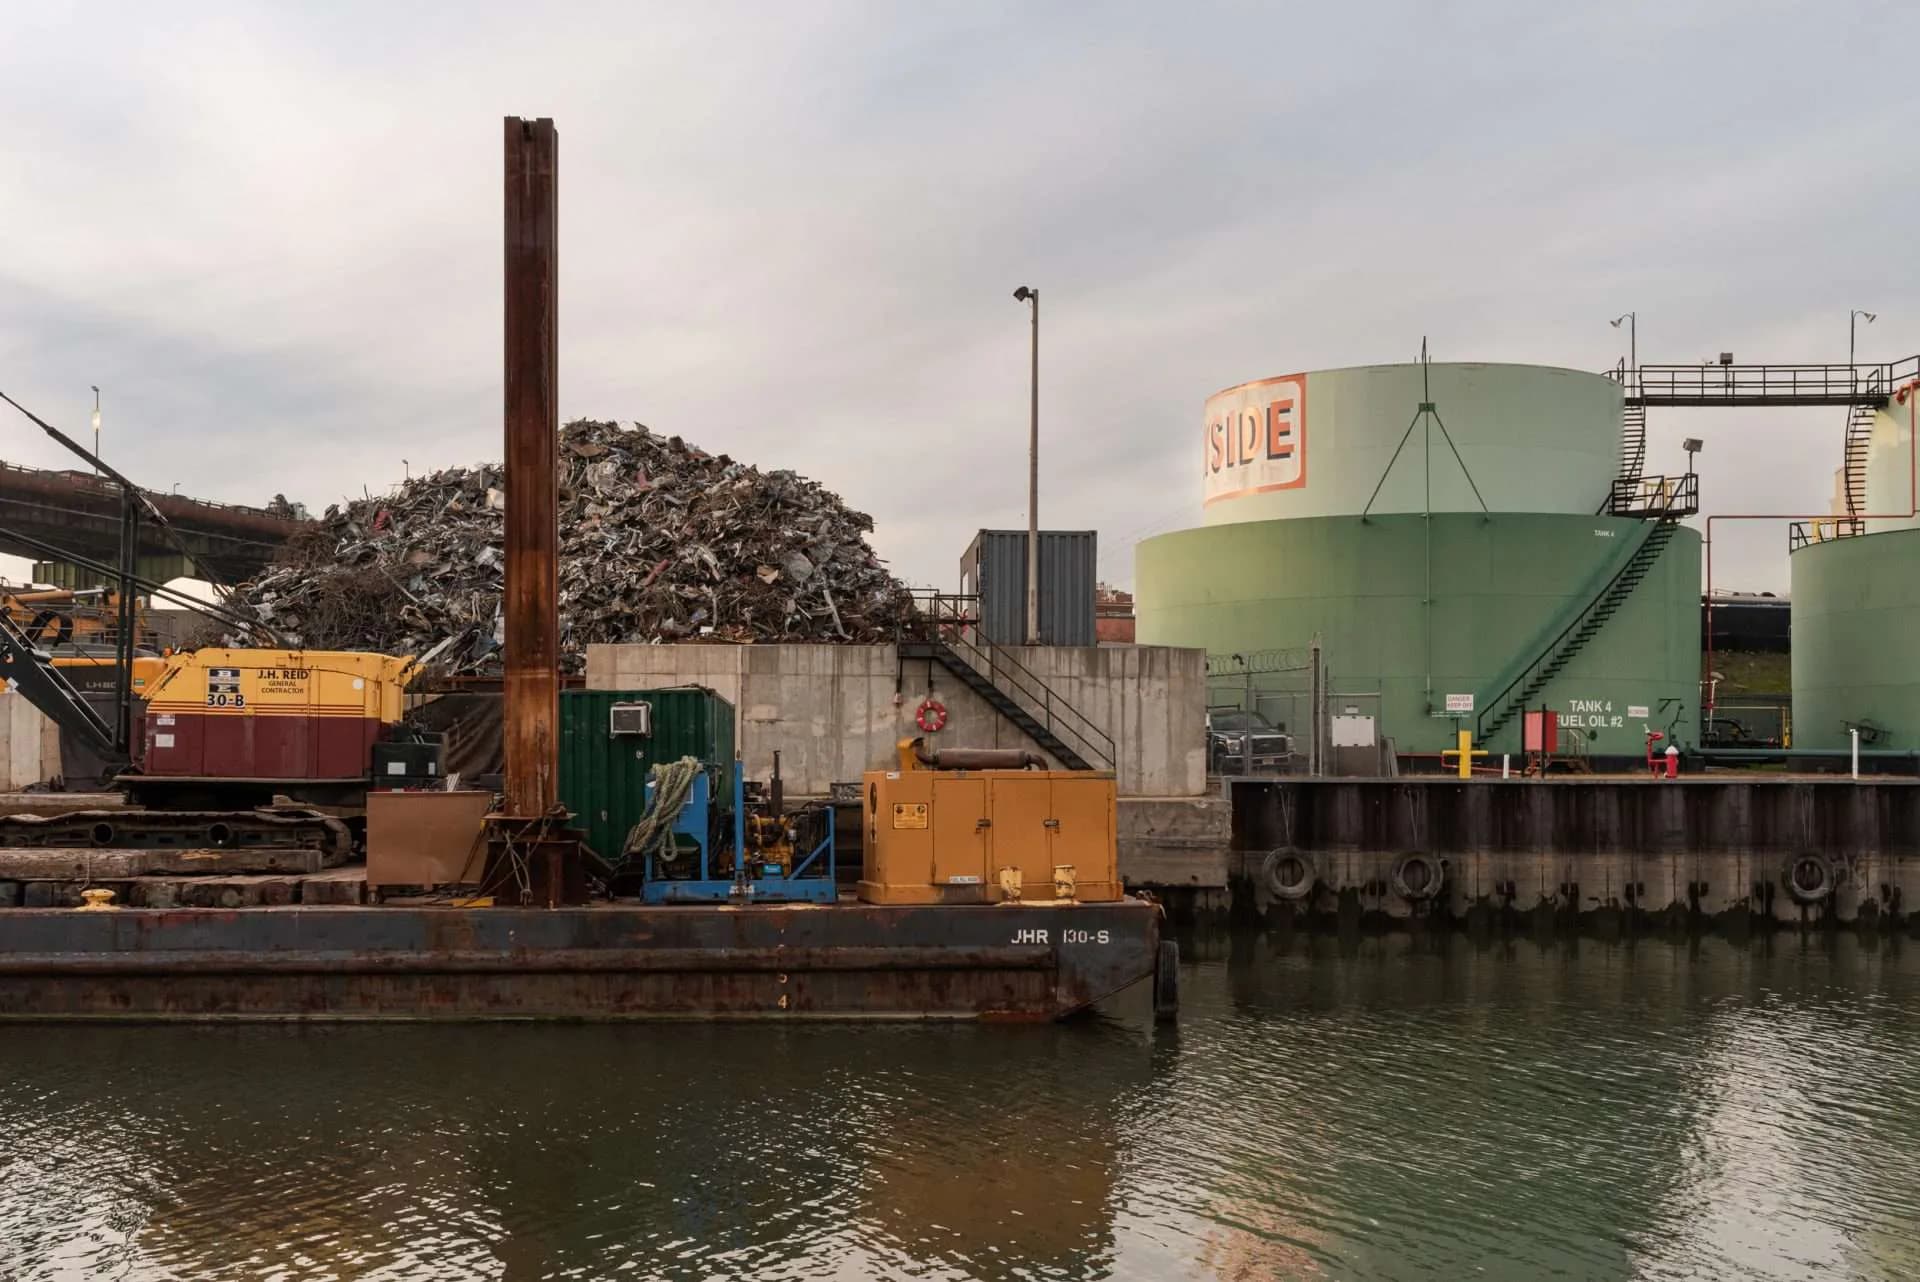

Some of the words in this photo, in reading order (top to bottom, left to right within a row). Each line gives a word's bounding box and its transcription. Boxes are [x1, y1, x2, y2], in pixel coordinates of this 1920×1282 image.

[1203, 399, 1295, 478] SIDE
[258, 670, 279, 679] J.H.
[283, 670, 309, 679] REID
[207, 694, 245, 706] 30-B
[1569, 700, 1602, 713] TANK
[1605, 701, 1612, 713] 4
[1588, 715, 1608, 727] OIL
[1610, 716, 1623, 728] #2
[1011, 929, 1048, 944] JHR
[778, 994, 787, 1008] 4
